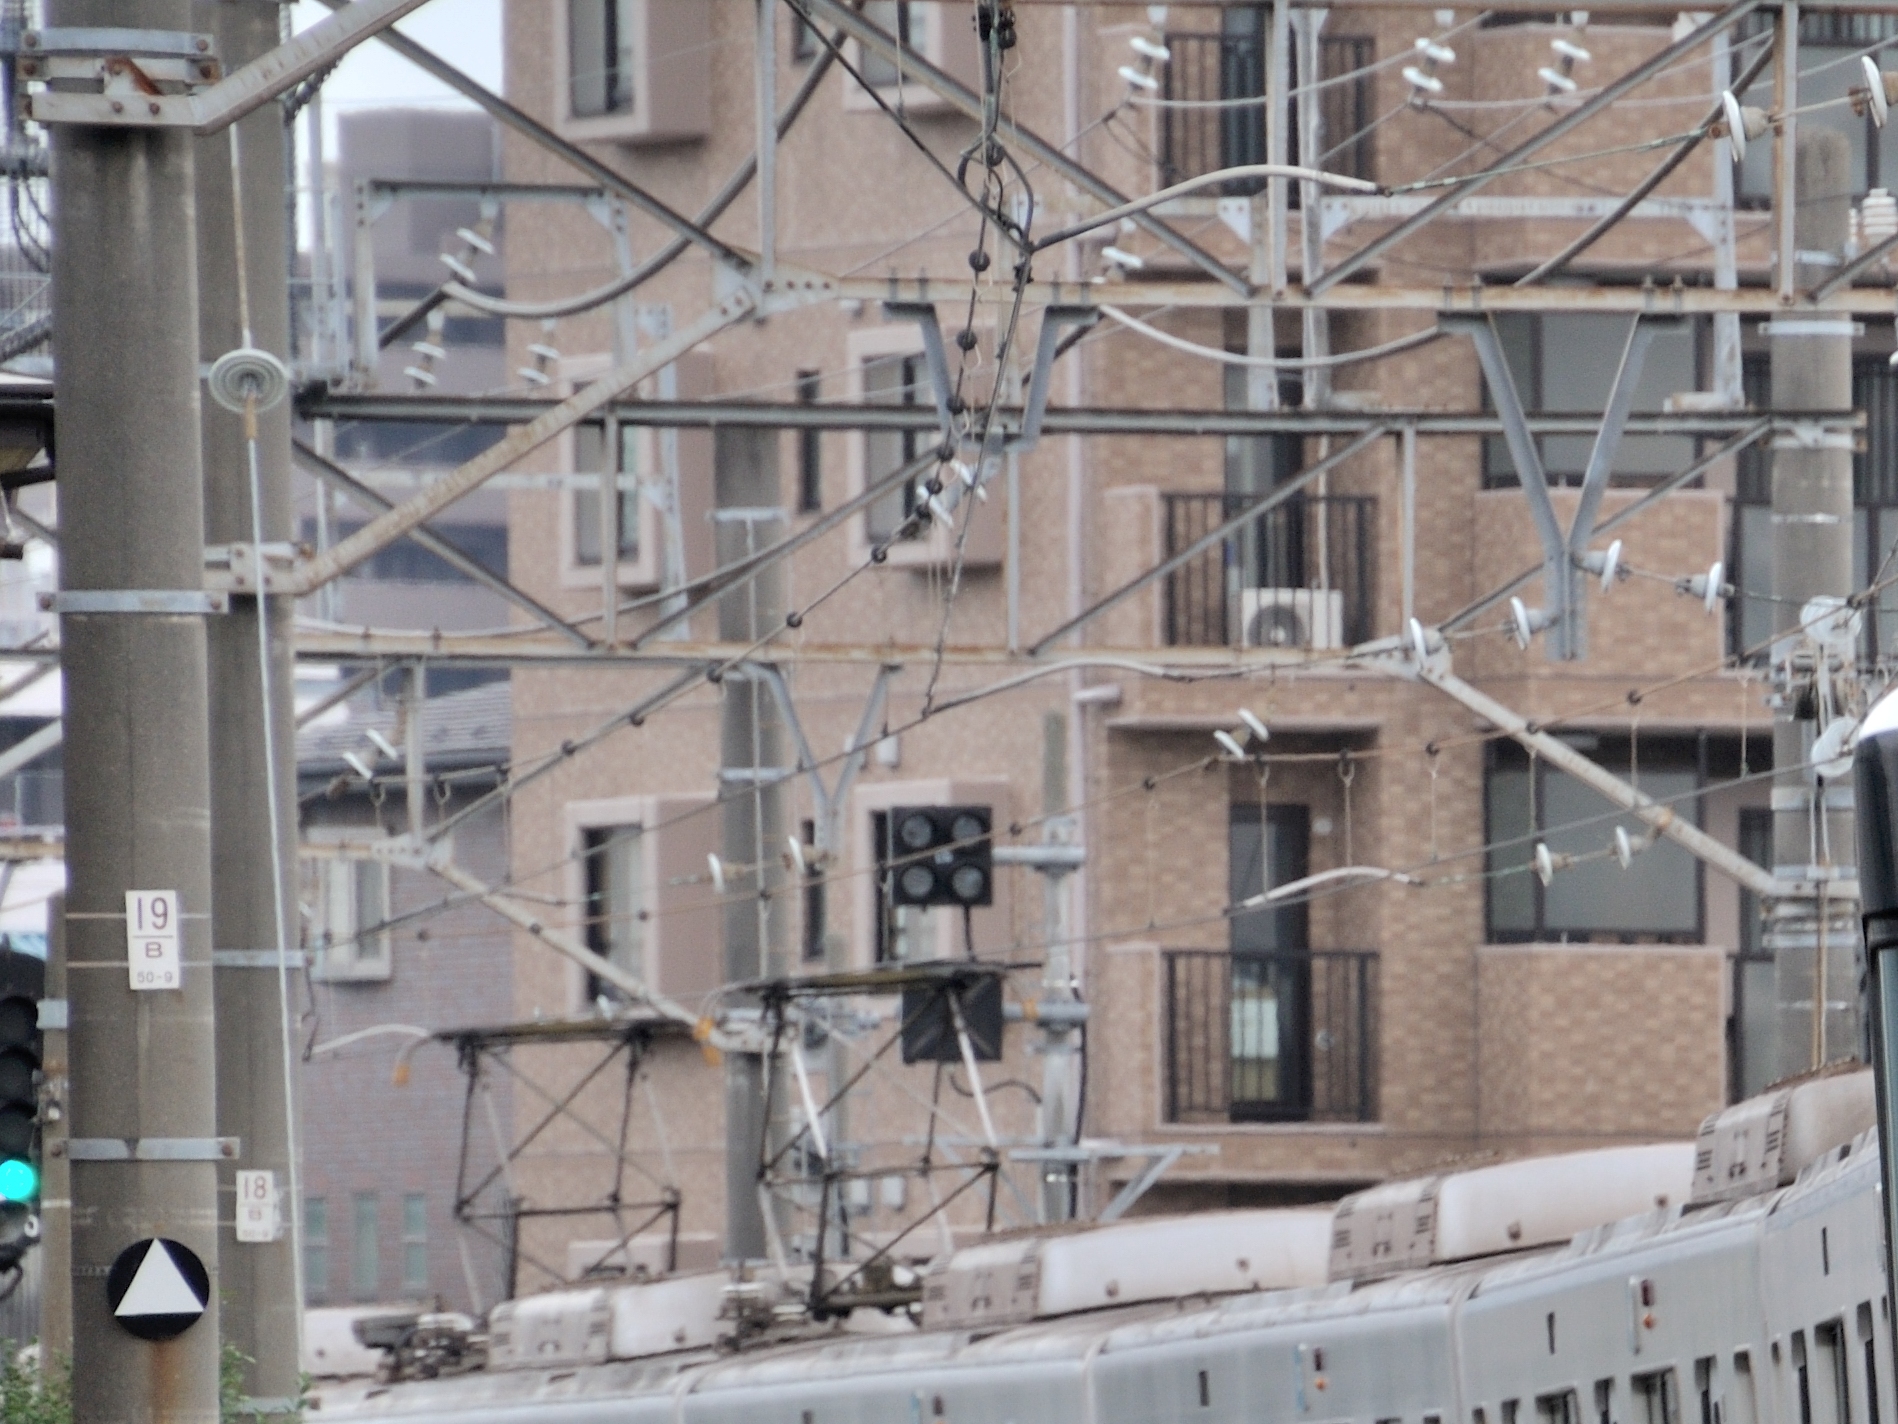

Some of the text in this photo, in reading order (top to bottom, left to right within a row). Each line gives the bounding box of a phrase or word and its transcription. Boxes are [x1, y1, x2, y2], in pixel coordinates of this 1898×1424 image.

[137, 896, 169, 931] 19
[145, 941, 163, 959] B
[243, 1174, 267, 1201] 18
